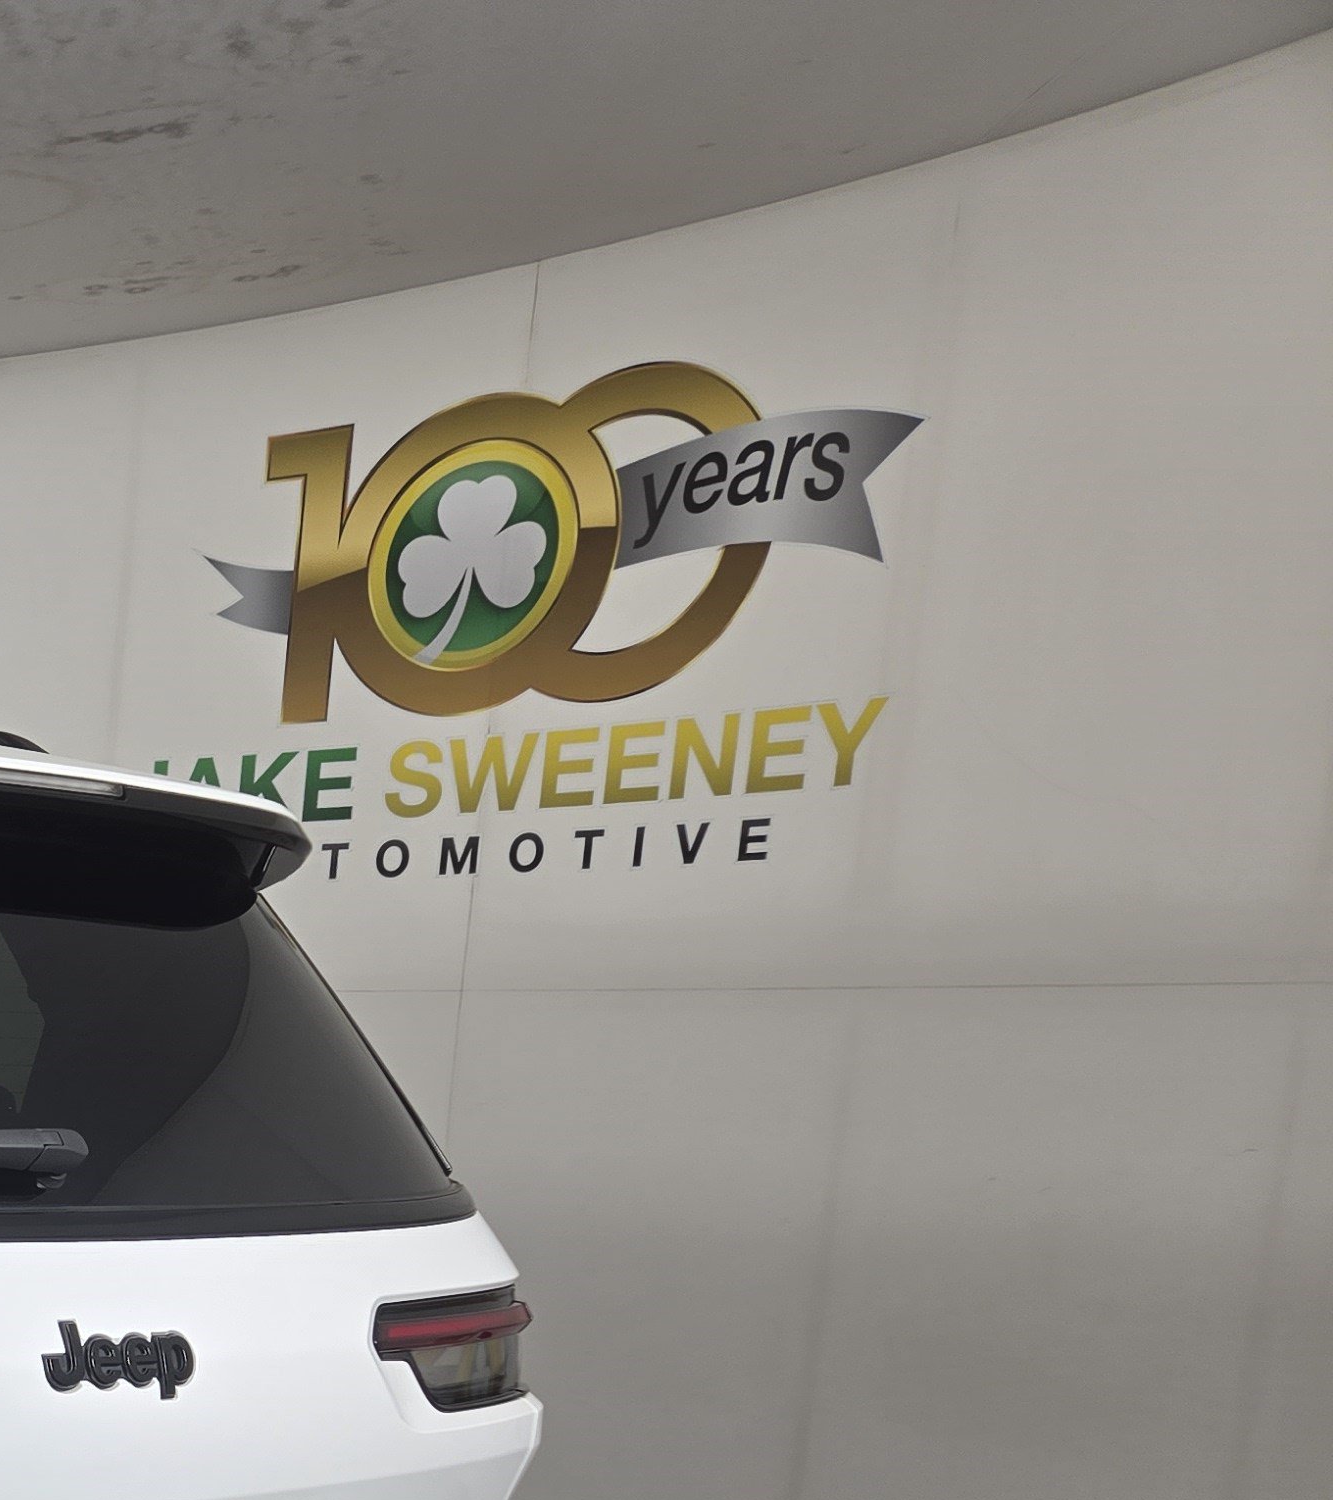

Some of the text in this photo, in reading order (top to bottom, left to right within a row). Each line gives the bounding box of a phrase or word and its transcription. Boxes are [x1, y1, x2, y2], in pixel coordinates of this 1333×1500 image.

[265, 361, 851, 723] 100 years
[153, 696, 889, 821] KE SWEENEY
[321, 817, 771, 880] TOMOTIVE
[41, 1319, 194, 1400] Jeep
